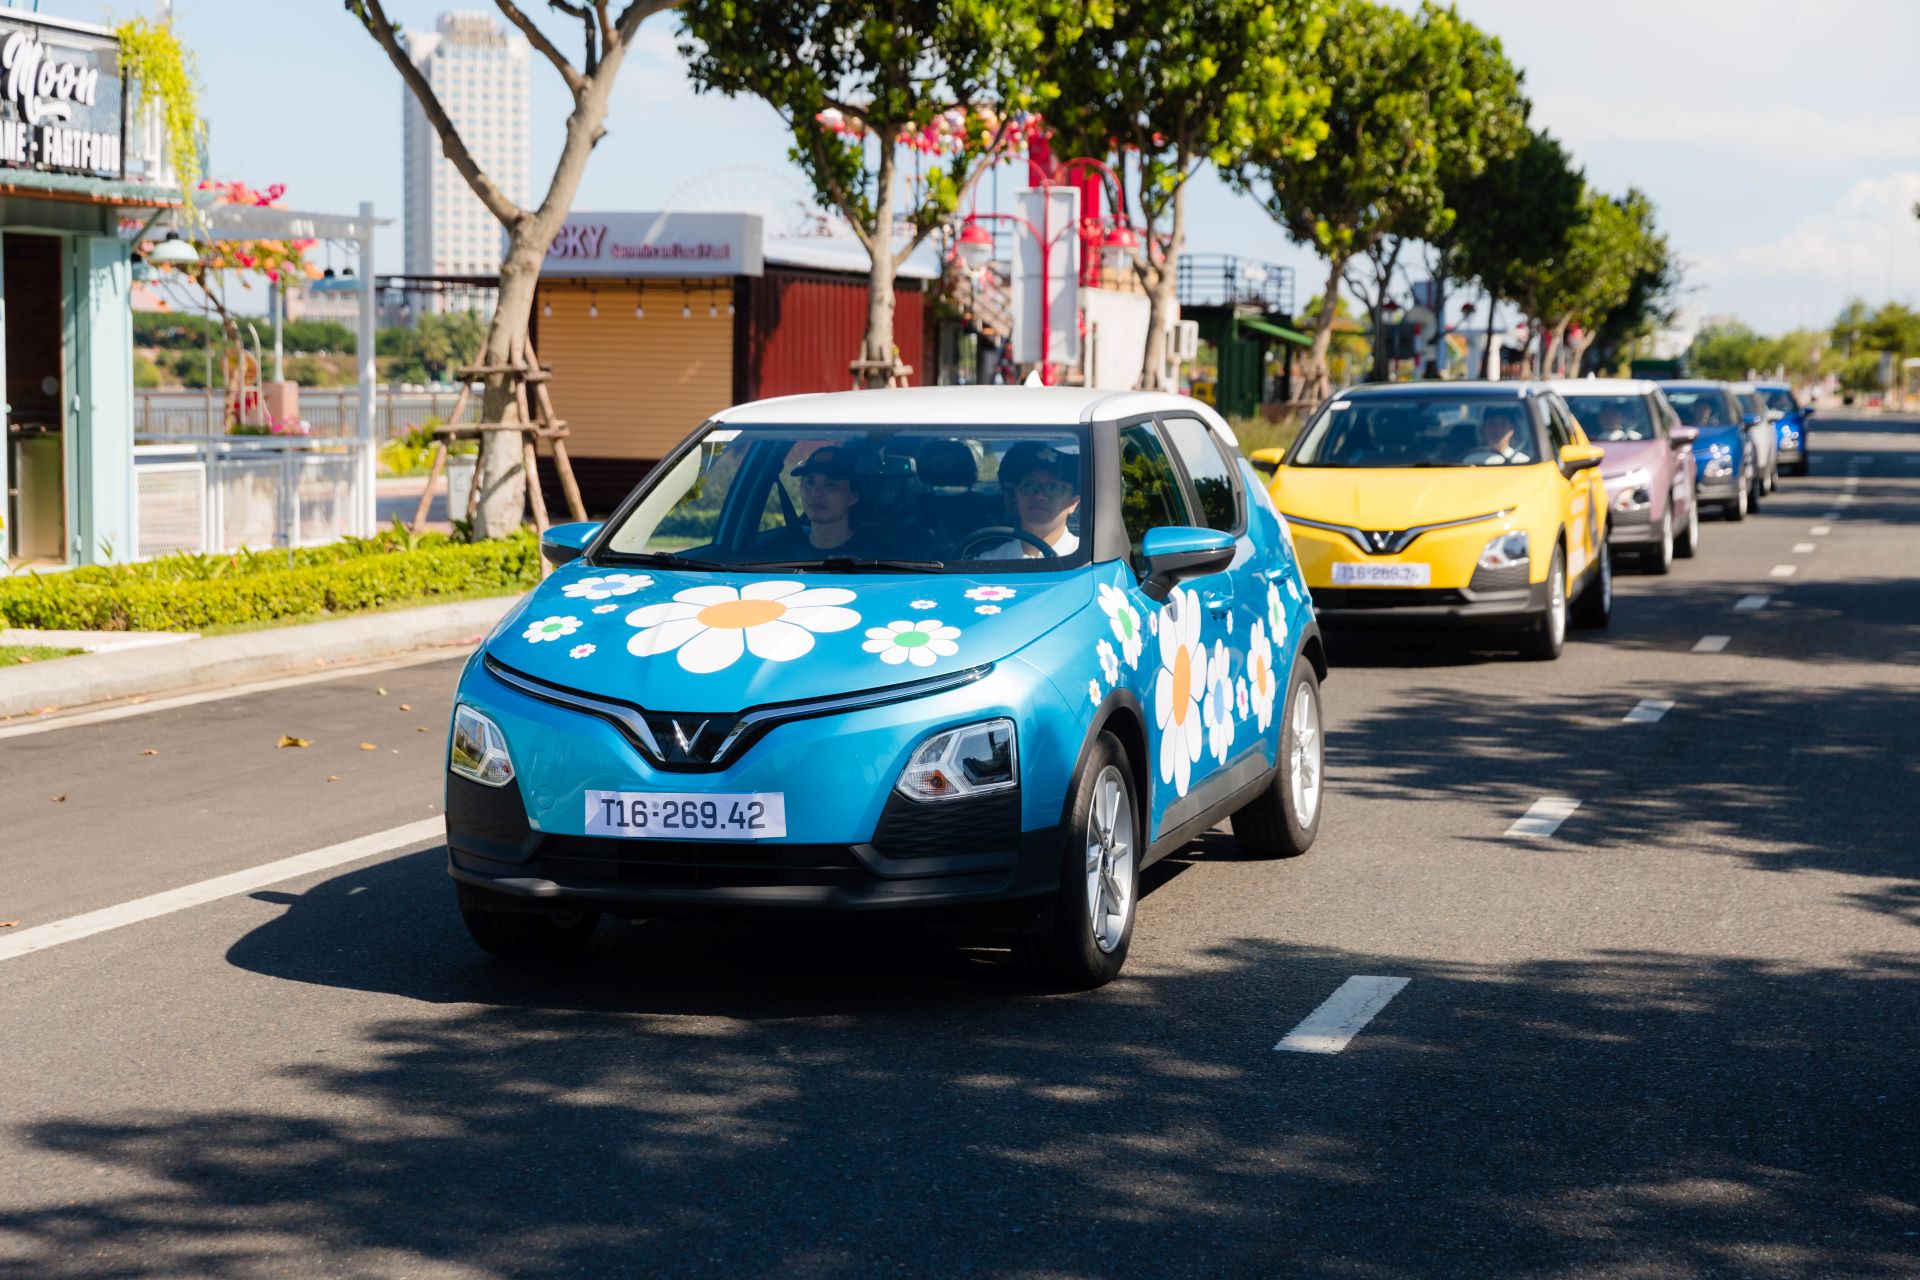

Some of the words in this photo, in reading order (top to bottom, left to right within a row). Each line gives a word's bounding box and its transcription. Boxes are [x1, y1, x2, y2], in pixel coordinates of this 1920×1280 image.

[3, 31, 98, 125] Moon
[43, 125, 120, 172] FASTFOOD
[548, 225, 608, 258] CKY
